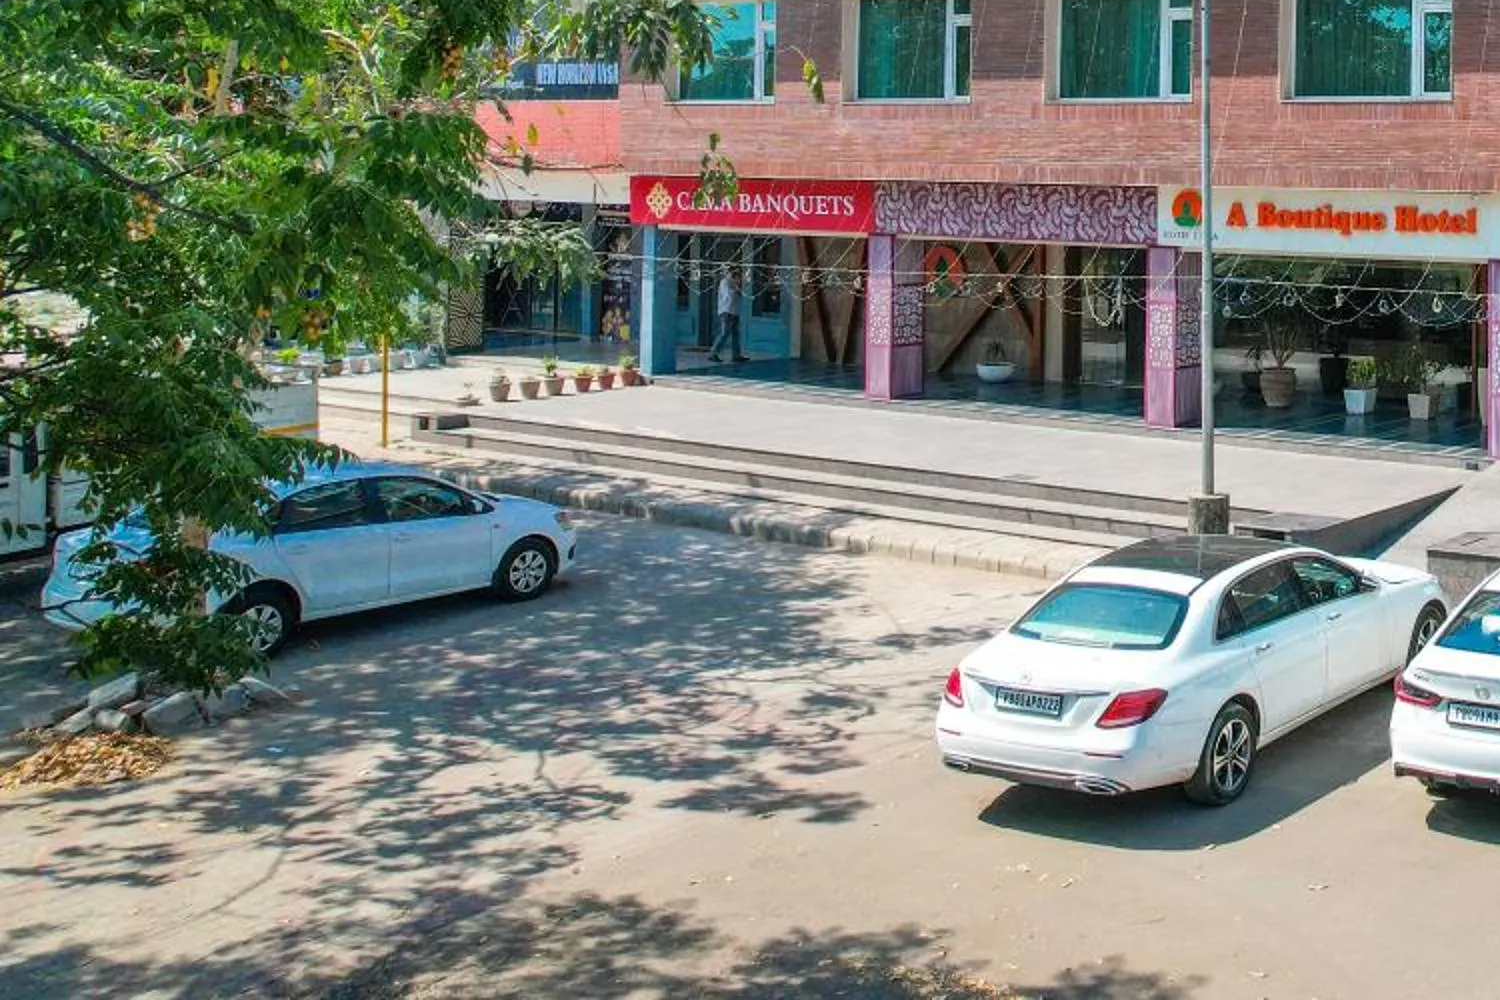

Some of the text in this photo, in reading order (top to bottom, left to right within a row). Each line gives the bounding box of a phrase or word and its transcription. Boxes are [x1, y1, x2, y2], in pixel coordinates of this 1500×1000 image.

[738, 193, 855, 220] BANQUETS
[1226, 202, 1478, 237] A Boutique Hotel
